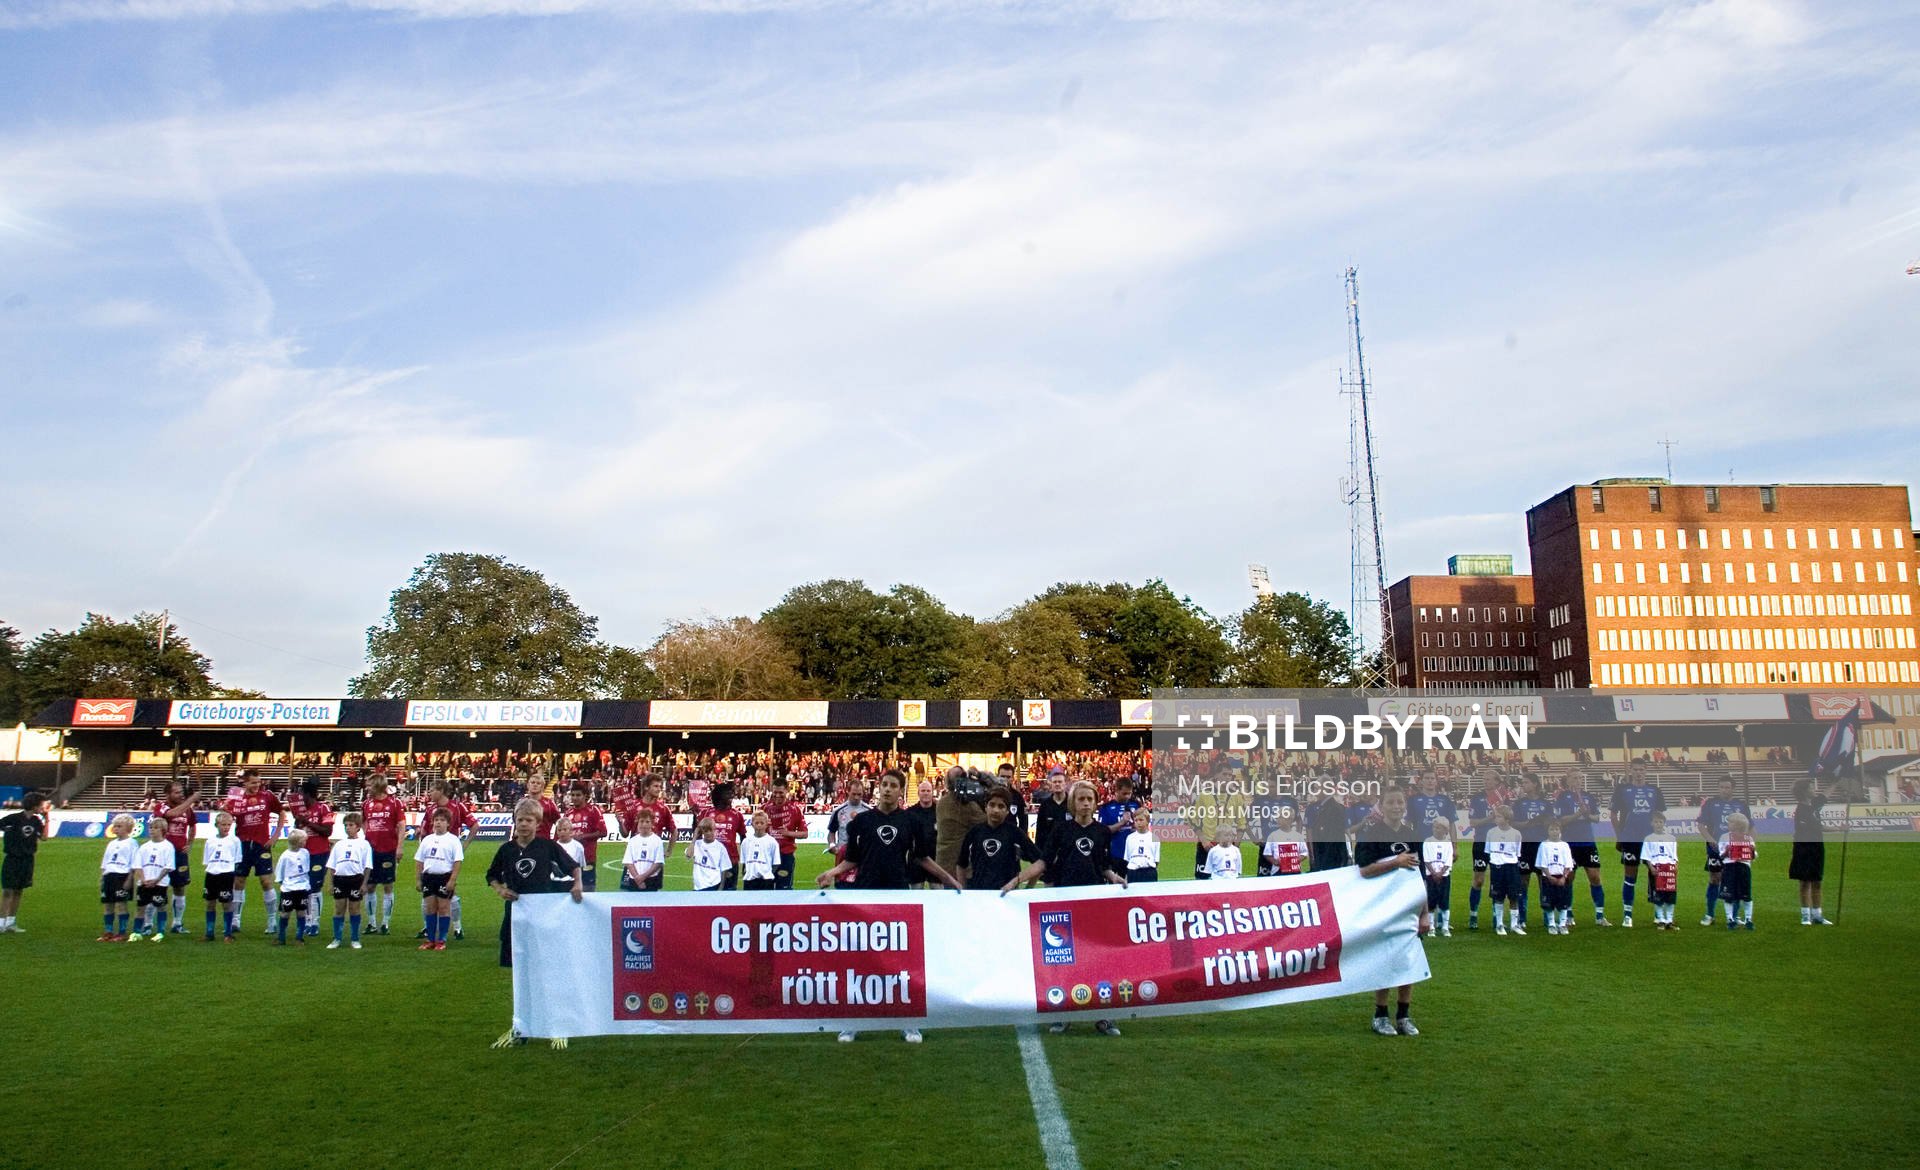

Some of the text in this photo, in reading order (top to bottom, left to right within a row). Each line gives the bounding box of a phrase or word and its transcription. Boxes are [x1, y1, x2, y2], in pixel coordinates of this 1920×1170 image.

[179, 703, 330, 723] Göteborgs-Posten
[702, 703, 777, 723] Renova
[1634, 799, 1650, 808] ICA
[1425, 809, 1439, 818] ICA
[477, 816, 513, 825] FRAK
[1474, 859, 1486, 867] ICA
[1041, 913, 1070, 923] UNITE
[1127, 897, 1322, 943] Ge rasismen
[623, 919, 652, 929] UNITE
[711, 916, 908, 954] Ge rasismen
[1045, 947, 1072, 956] AGAINST
[625, 954, 651, 962] AGAINST
[1045, 955, 1073, 964] RACISM
[625, 961, 652, 970] RACISM
[1203, 942, 1329, 986] rött kort
[781, 968, 912, 1005] rött kort
